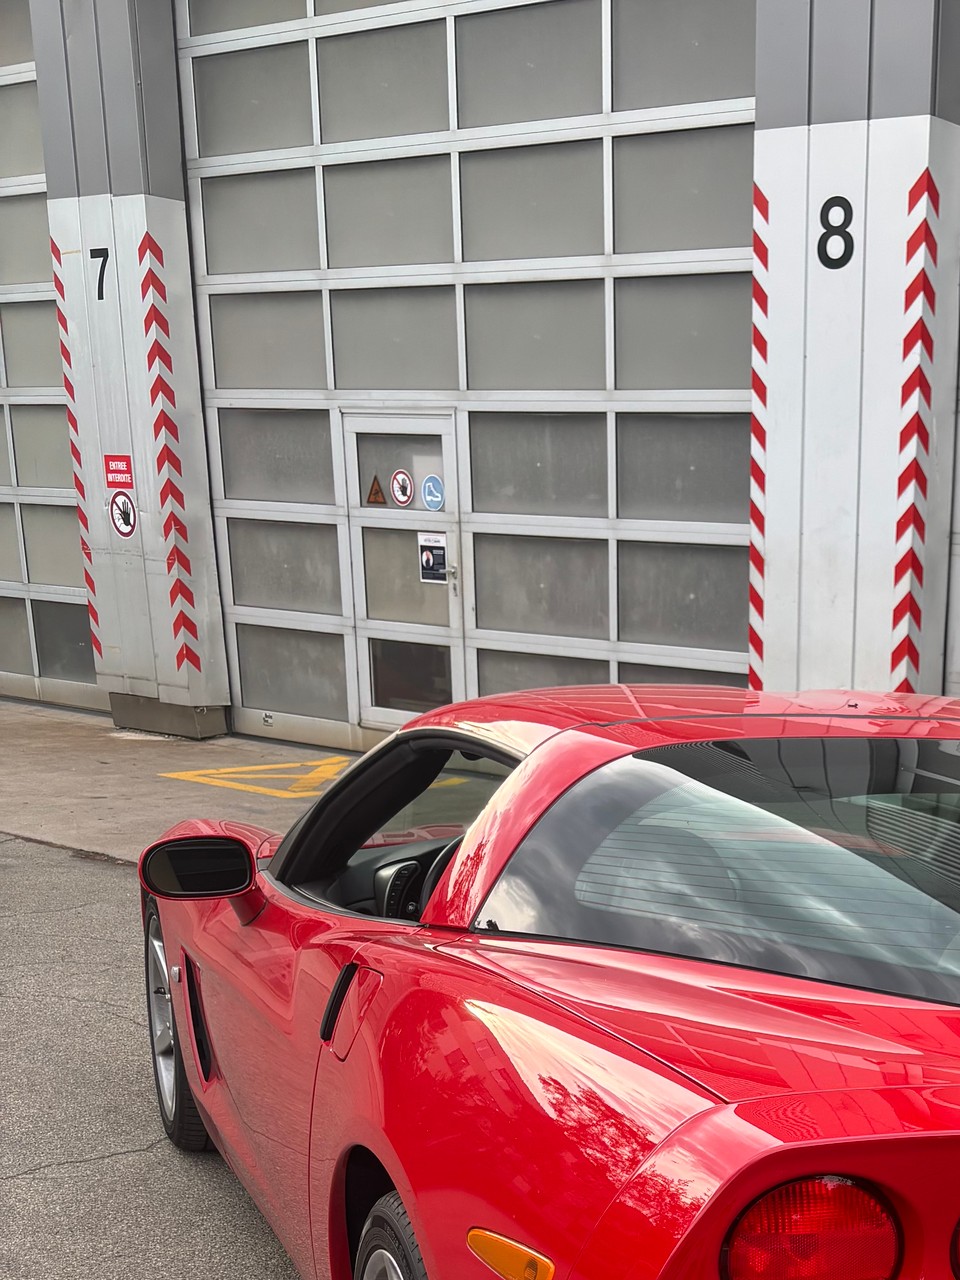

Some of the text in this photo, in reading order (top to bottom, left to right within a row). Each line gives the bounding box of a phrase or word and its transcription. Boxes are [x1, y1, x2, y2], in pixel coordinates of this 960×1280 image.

[817, 195, 854, 270] 8
[88, 247, 110, 300] 7
[107, 473, 132, 483] INTERDITE
